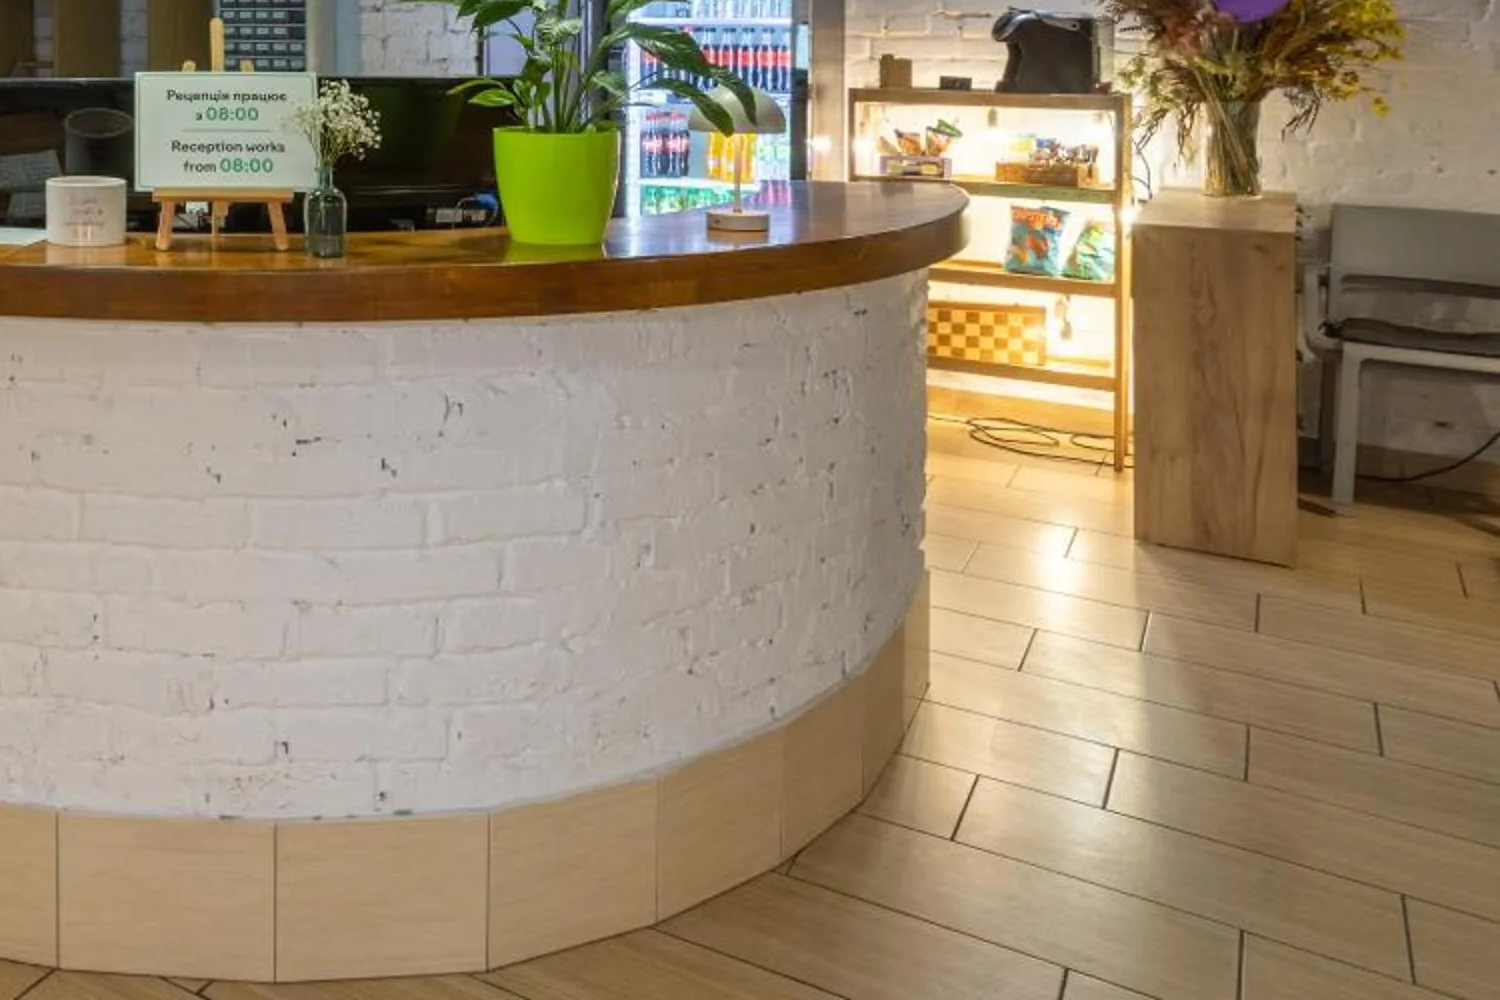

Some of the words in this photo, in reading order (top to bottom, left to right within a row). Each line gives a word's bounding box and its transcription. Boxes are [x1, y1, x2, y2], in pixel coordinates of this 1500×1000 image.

[166, 89, 229, 103] Рецепція
[233, 91, 287, 104] працює
[206, 107, 259, 121] 08:00
[171, 139, 243, 154] Reception
[245, 140, 286, 153] works
[183, 160, 216, 173] from
[219, 158, 274, 173] 08:00
